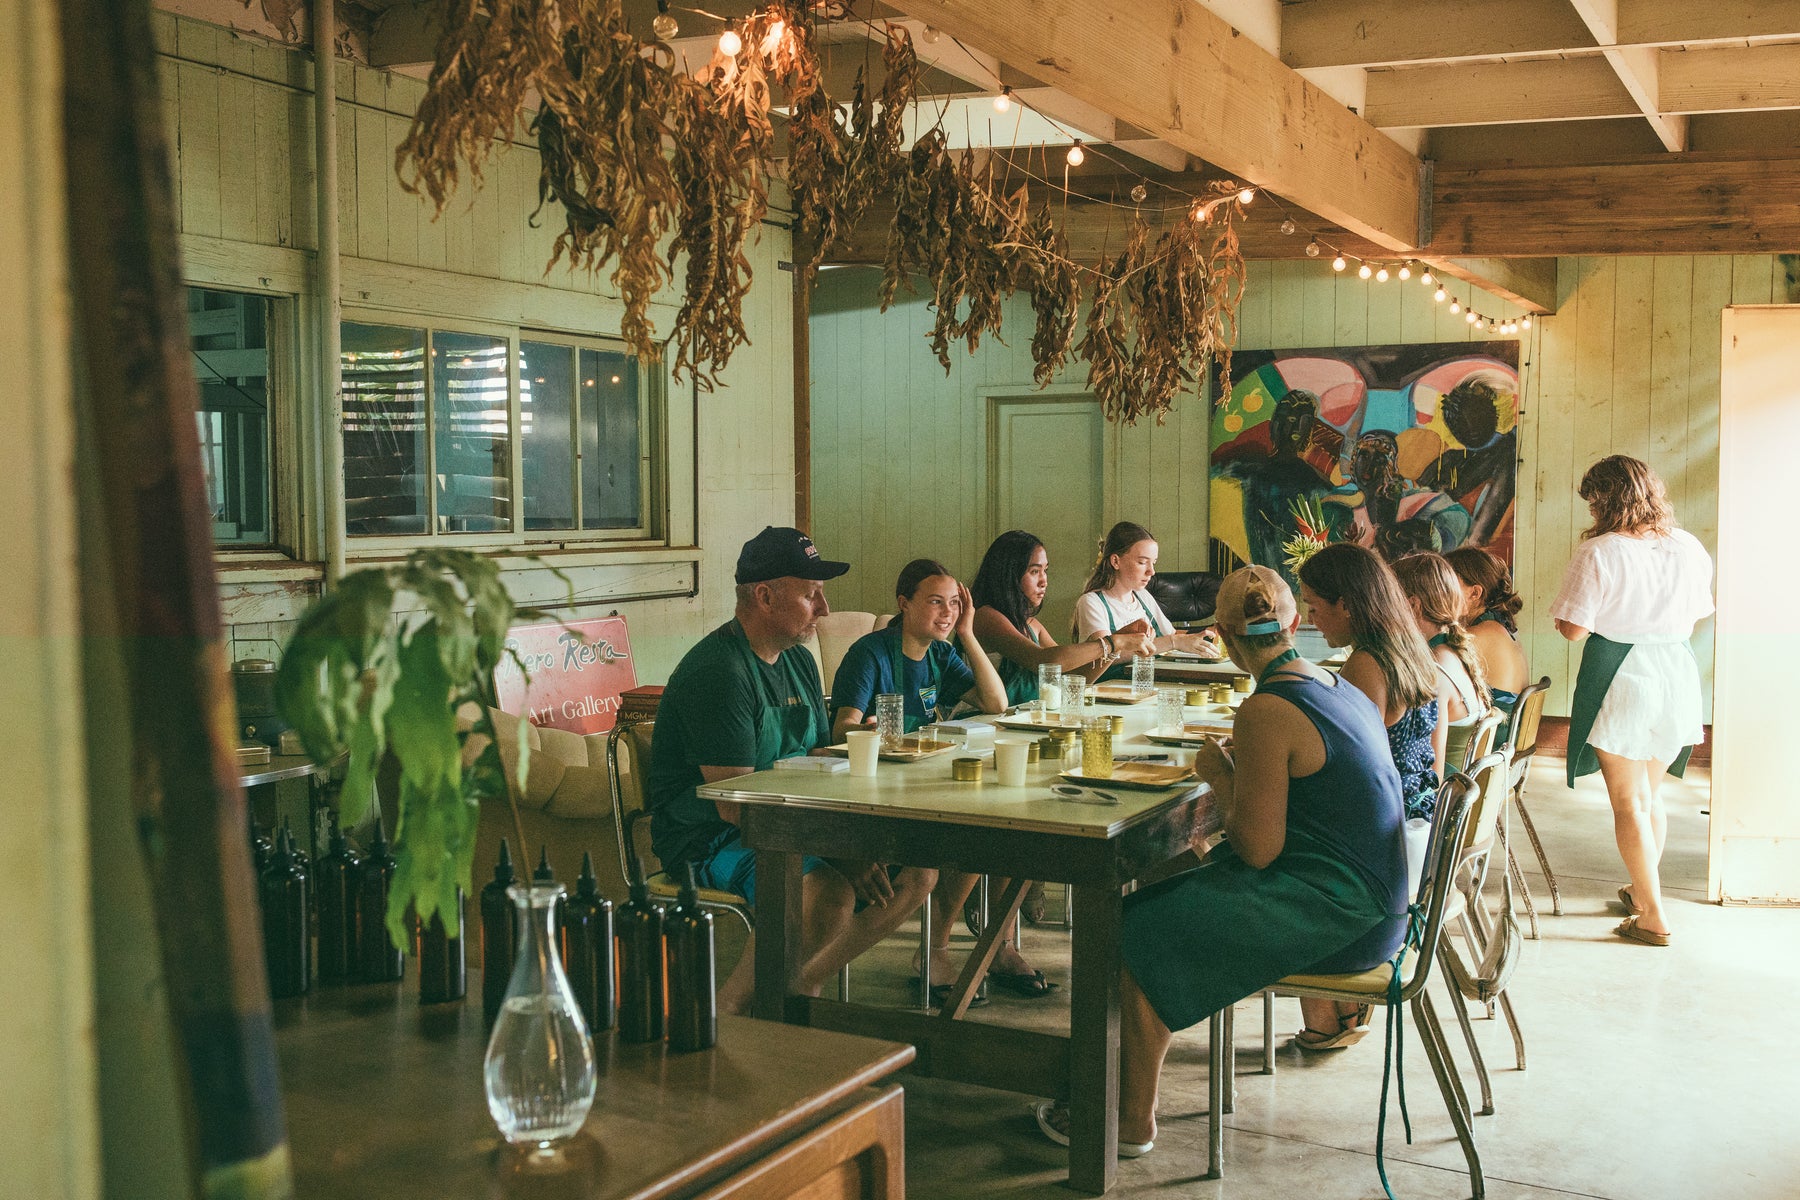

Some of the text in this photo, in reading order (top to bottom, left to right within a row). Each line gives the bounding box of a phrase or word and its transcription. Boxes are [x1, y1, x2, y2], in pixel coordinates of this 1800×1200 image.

[557, 631, 628, 672] Resta
[529, 695, 622, 726] Art Gallery
[624, 711, 648, 721] MGM
